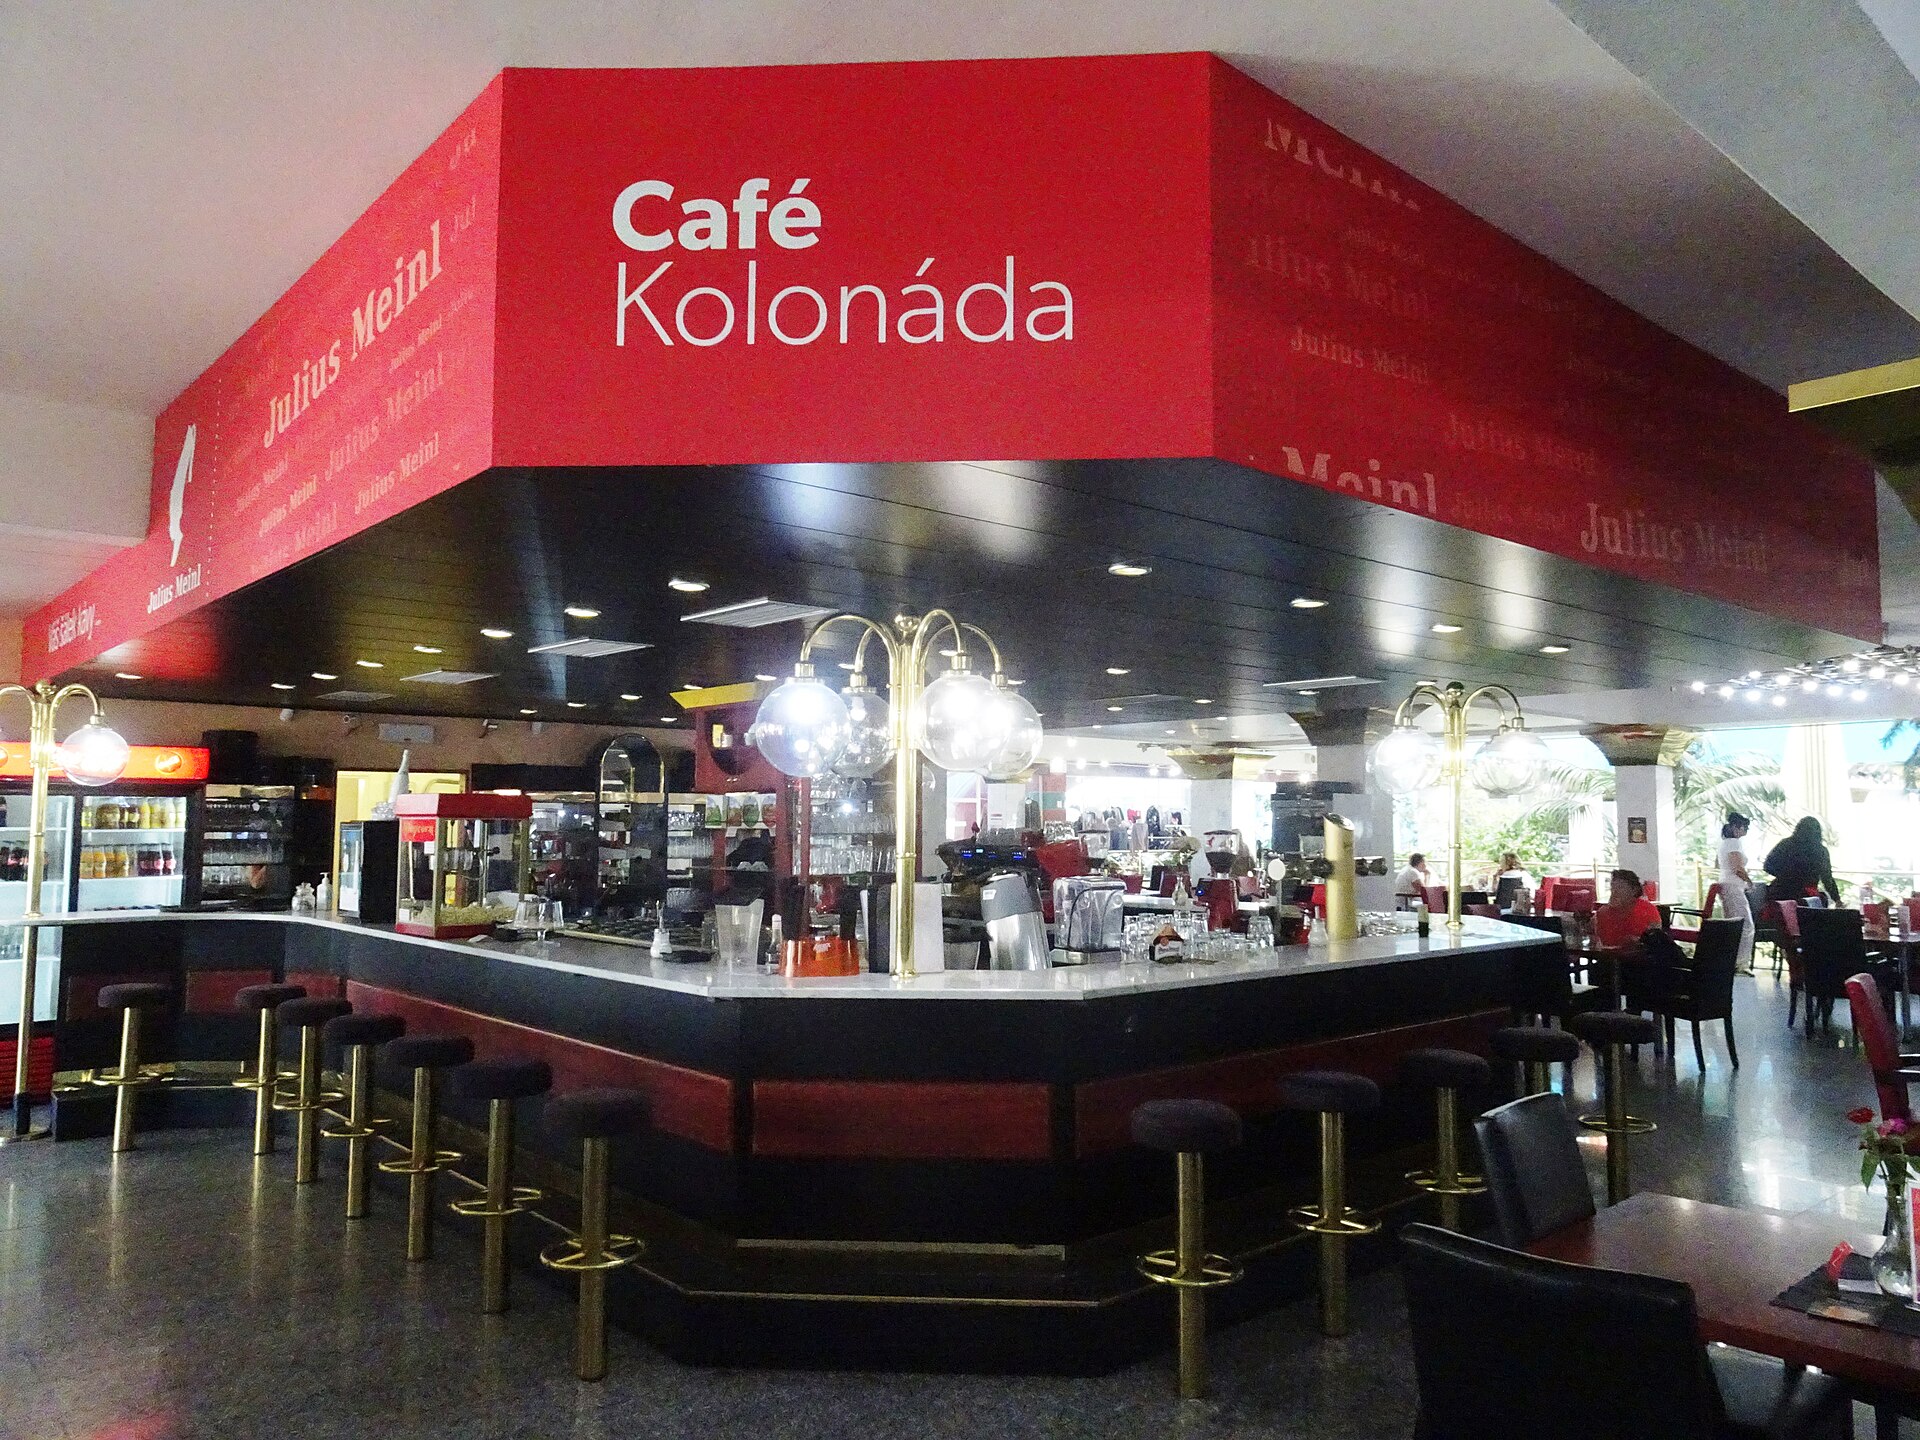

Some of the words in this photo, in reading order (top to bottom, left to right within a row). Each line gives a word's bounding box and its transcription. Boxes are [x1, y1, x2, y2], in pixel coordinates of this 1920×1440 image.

[612, 177, 822, 251] Café
[263, 338, 341, 449] Julius
[350, 218, 443, 362] Meinl
[615, 255, 1073, 347] Kolonáda
[1580, 502, 1686, 563] Julius
